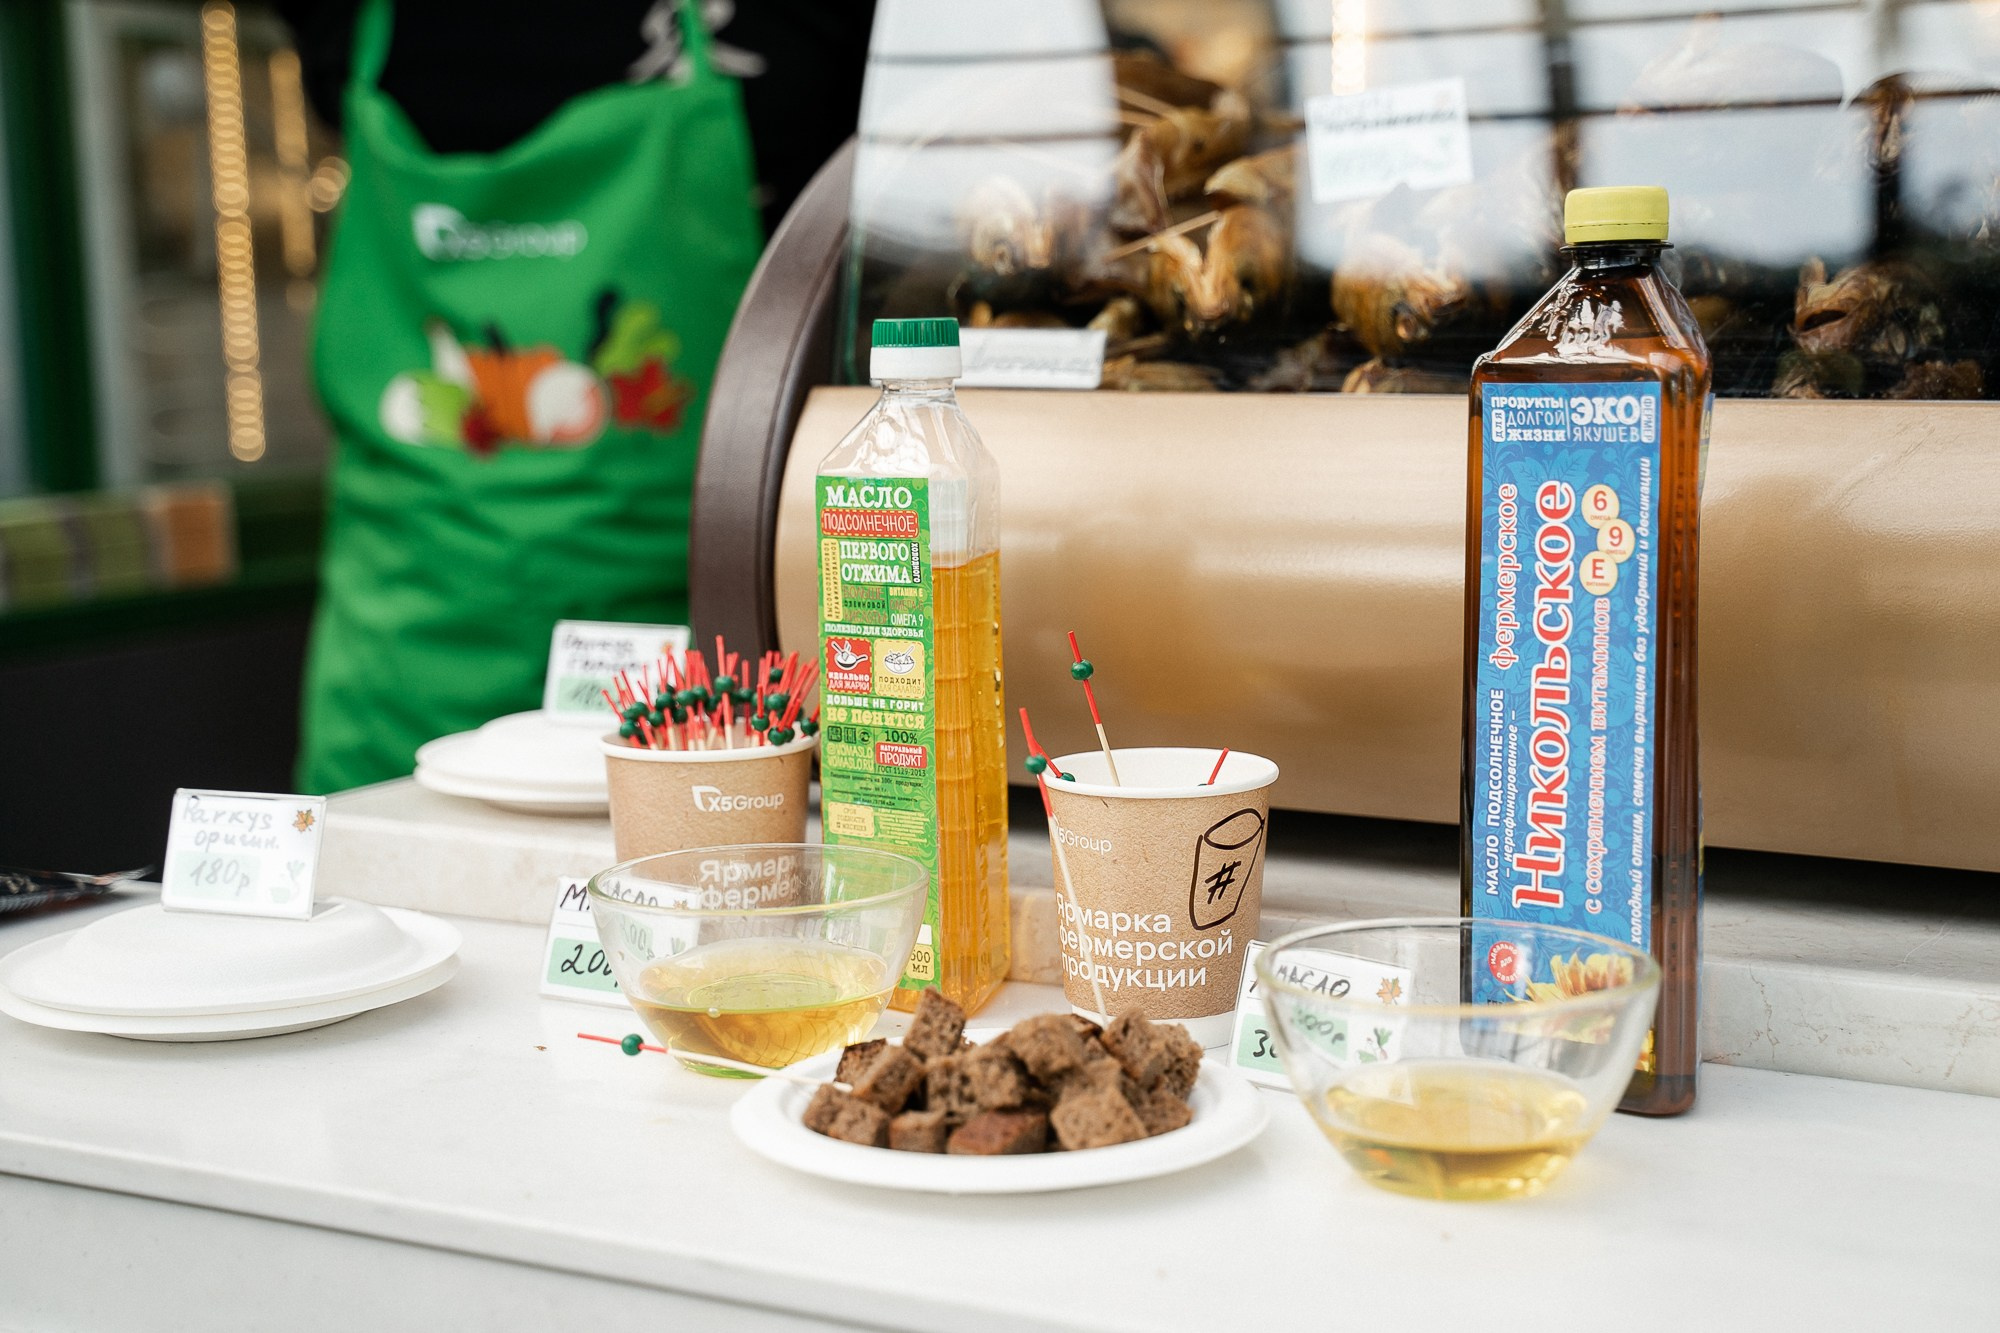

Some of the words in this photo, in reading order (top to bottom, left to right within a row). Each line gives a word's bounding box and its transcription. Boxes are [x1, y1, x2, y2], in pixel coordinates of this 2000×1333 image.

[1491, 396, 1564, 410] ПРОДУКТЫ
[1570, 395, 1641, 426] ЭКО
[1507, 409, 1565, 428] ДОЛГОЙ
[1573, 426, 1640, 443] ЯКУШЕВ
[825, 485, 912, 508] МАСЛО
[1593, 490, 1607, 511] 6
[1636, 456, 1652, 538] десикации
[823, 512, 915, 533] ПОДСОЛНЕЧНОЕ
[1608, 526, 1623, 547] 9
[1638, 539, 1649, 551] и
[840, 541, 909, 561] ПЕРВОГО
[911, 542, 921, 583] ХОЛОДНОГО
[841, 563, 911, 583] ОТЖИМА
[1489, 483, 1521, 671] фермерское
[1634, 551, 1650, 635] удобрений
[825, 623, 862, 634] ПОЛЕЗНО
[863, 625, 880, 636] ДЛЯ
[881, 627, 924, 638] ЗДОРОВЬЯ
[891, 613, 917, 626] ОМЕГА
[919, 614, 924, 627] 9
[1633, 636, 1647, 663] без
[828, 671, 870, 682] ИДЕАЛЬНО
[1591, 597, 1611, 732] витаминов
[829, 679, 843, 689] ДЛЯ
[844, 680, 870, 691] ЖАРКИ
[879, 676, 921, 686] ПОДХОДИТ
[827, 694, 869, 708] ДОЛЬШЕ
[873, 698, 886, 709] НЕ
[890, 700, 925, 712] ГОРИТ
[1512, 480, 1576, 908] Никольское
[1634, 665, 1648, 744] выращена
[885, 730, 918, 744] 100%
[879, 752, 923, 767] ПРОДУКТ
[1487, 688, 1504, 827] ПОДСОЛНЕЧНОЕ
[878, 766, 892, 774] ГОСТ
[893, 766, 926, 777] 1129-2013
[1632, 746, 1645, 807] семечка
[1503, 724, 1518, 862] нерафинированное
[1585, 735, 1608, 895] сохранением
[1631, 810, 1646, 867] отжим,
[1486, 835, 1500, 896] МАСЛО
[1056, 892, 1172, 937] Ярмарка
[1628, 869, 1644, 946] холодный
[1059, 928, 1234, 967] фермерской
[1061, 951, 1207, 993] продукции
